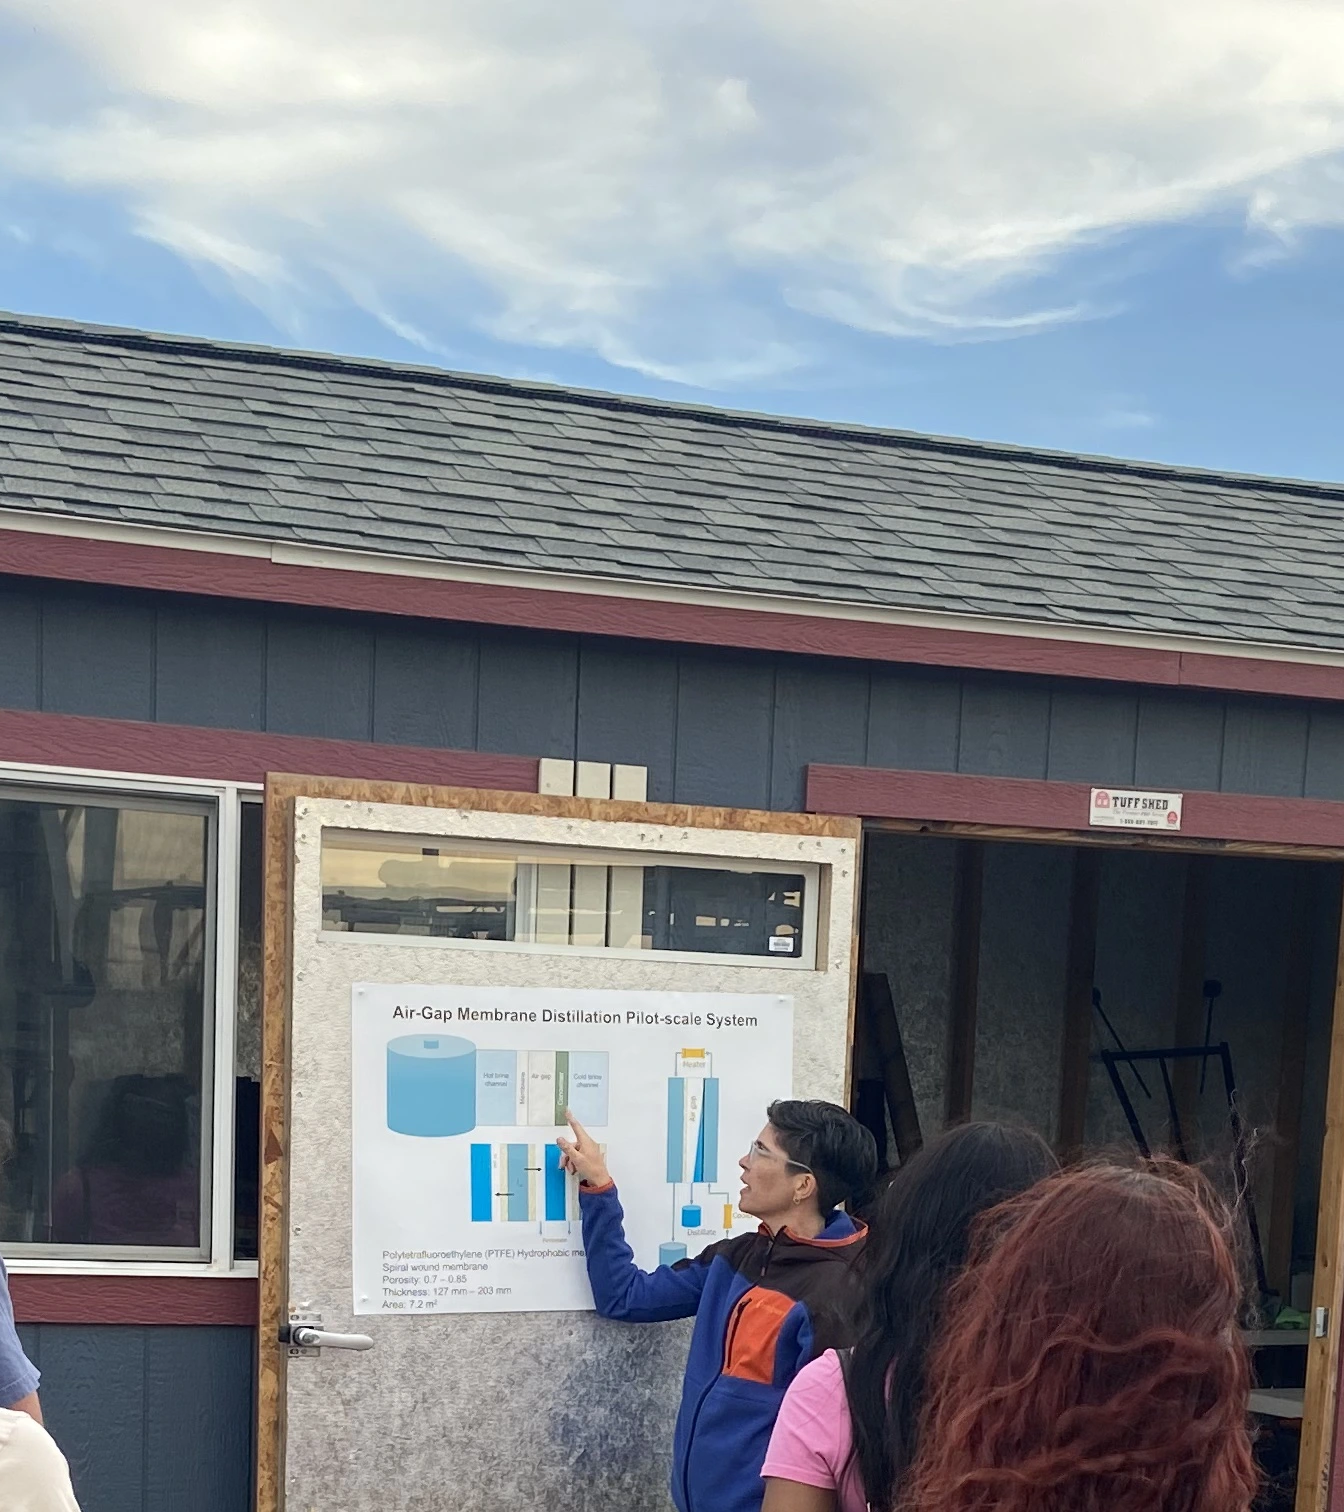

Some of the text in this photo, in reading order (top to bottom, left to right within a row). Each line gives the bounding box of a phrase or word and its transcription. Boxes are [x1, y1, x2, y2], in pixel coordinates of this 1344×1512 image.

[1112, 796, 1169, 811] TUFF SHED
[392, 1005, 758, 1029] Air-Gap Membrane Distillation Pilot-scale System
[682, 1060, 706, 1069] Heater
[382, 1250, 483, 1261] Polytetrafluoroethylene
[484, 1249, 516, 1260] (PTFE)
[517, 1249, 570, 1259] Hydrophobic
[382, 1262, 489, 1273] Spiral wound membrane
[382, 1275, 421, 1286] Porosity:
[423, 1275, 438, 1284] 0.7
[447, 1274, 468, 1284] 0.85
[382, 1287, 431, 1297] Thickness:
[433, 1286, 449, 1296] 127
[451, 1288, 468, 1296] mm
[477, 1286, 494, 1296] 203
[495, 1287, 512, 1296] mm
[381, 1299, 407, 1309] Area:
[409, 1299, 424, 1309] 7.2
